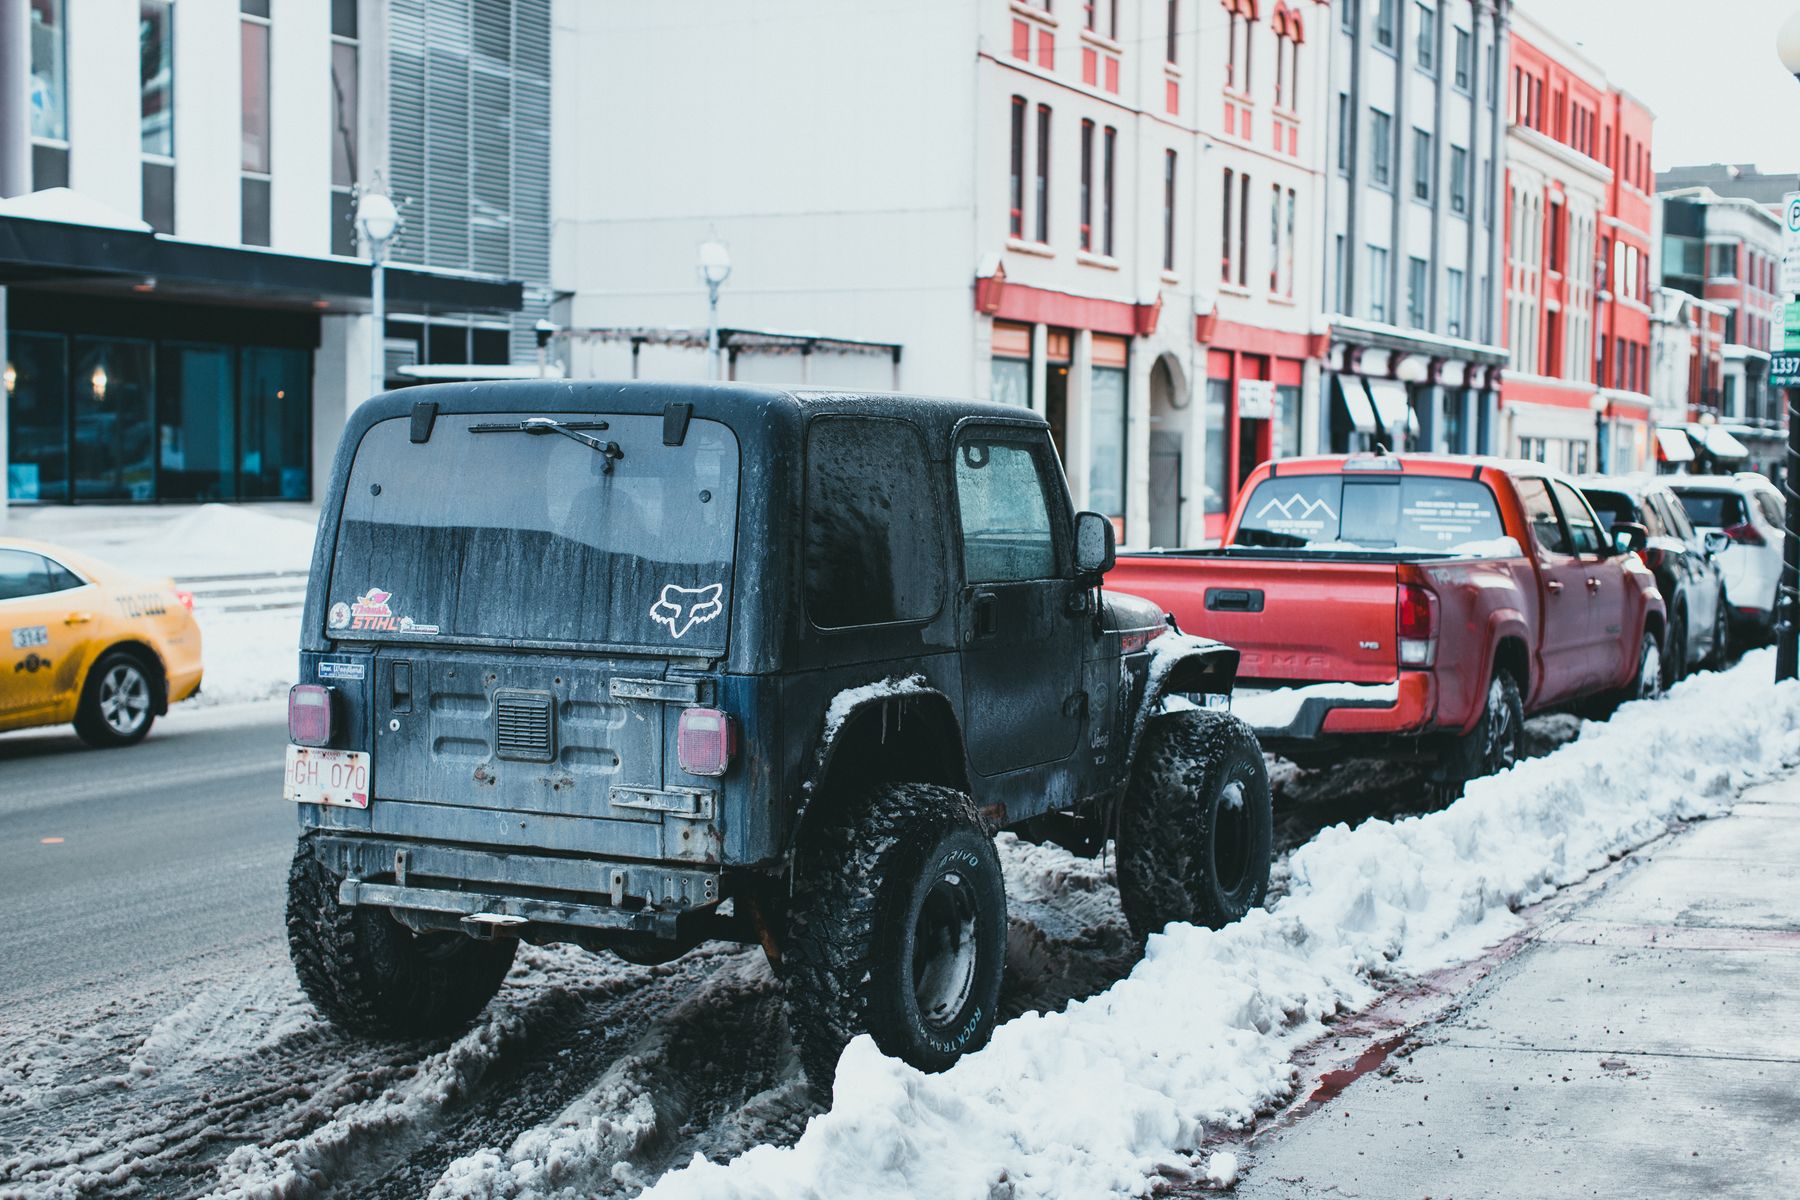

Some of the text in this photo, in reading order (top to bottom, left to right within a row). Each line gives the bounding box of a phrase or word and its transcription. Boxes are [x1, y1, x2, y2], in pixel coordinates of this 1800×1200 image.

[1771, 357, 1800, 374] 1337
[351, 616, 398, 631] STIHL
[1240, 653, 1331, 668] OMA
[1091, 728, 1110, 748] Jeep
[331, 763, 366, 790] 070
[958, 1007, 982, 1045] ROCK
